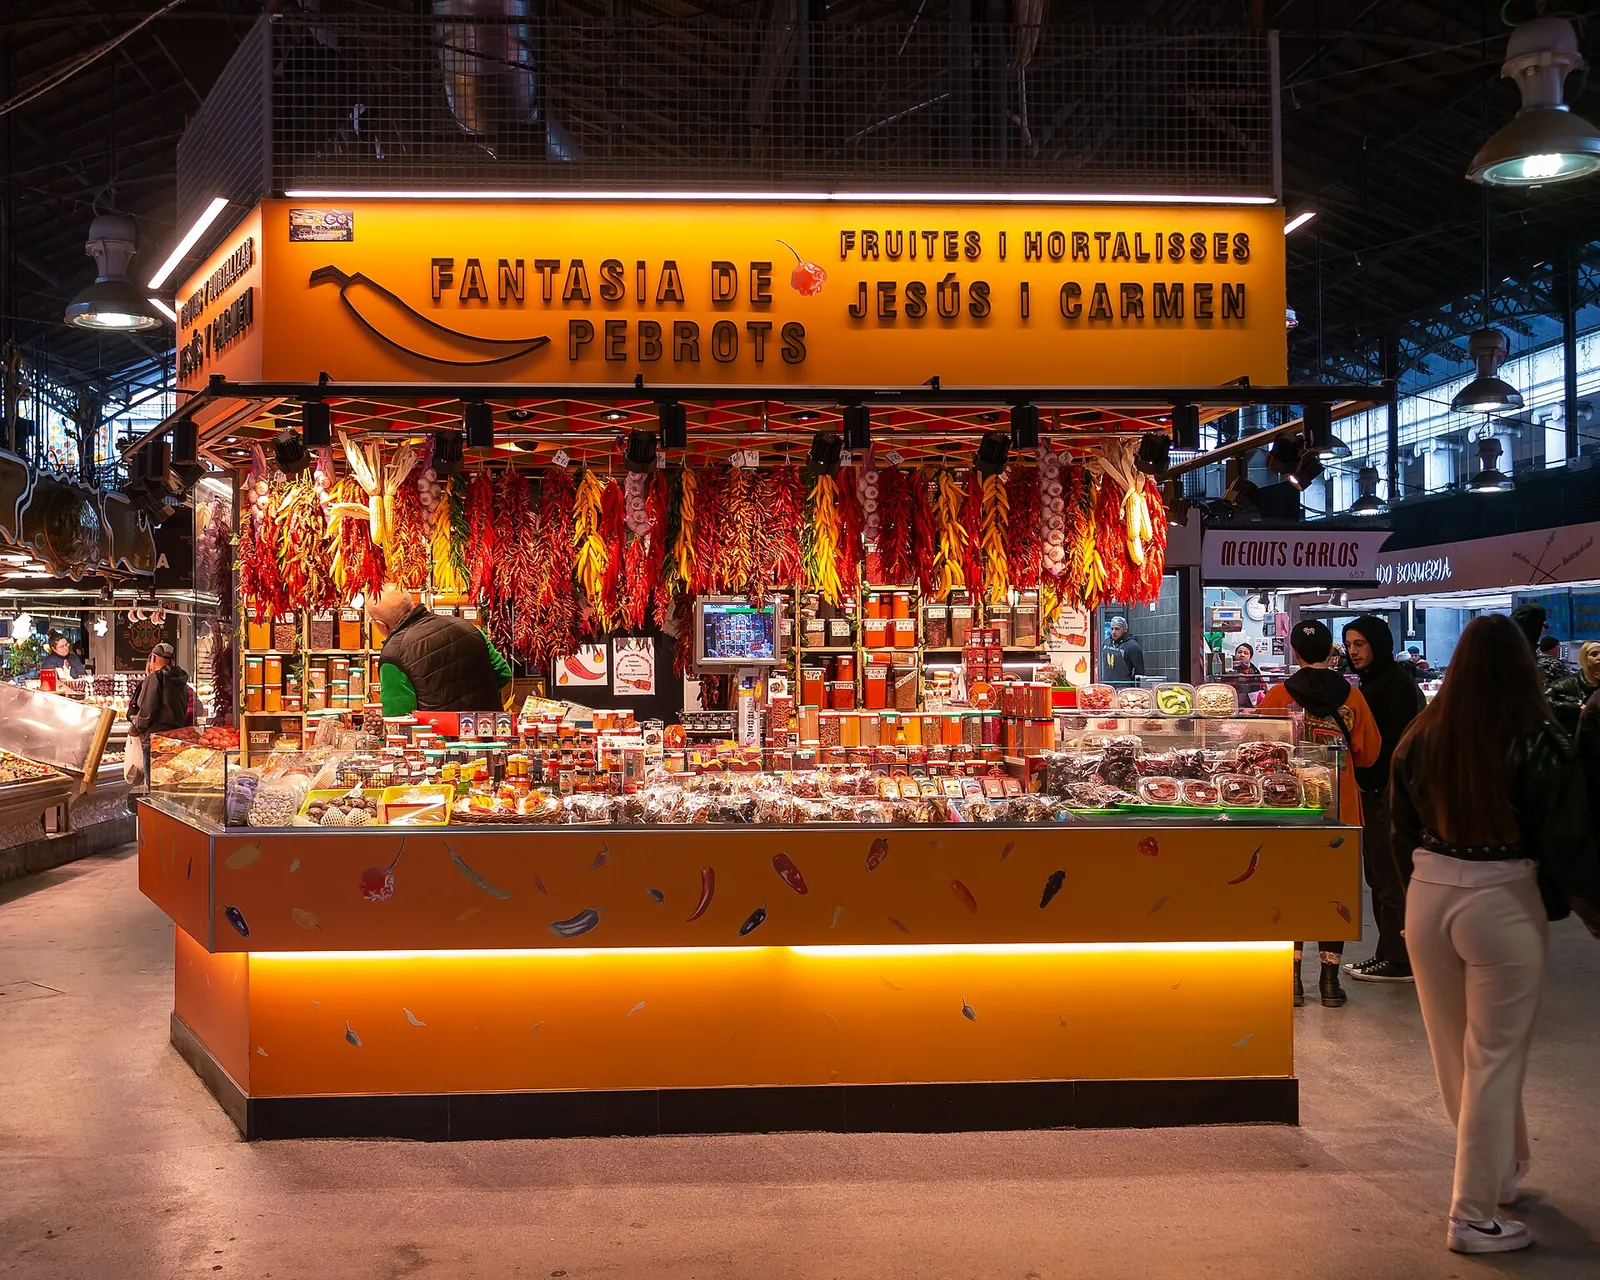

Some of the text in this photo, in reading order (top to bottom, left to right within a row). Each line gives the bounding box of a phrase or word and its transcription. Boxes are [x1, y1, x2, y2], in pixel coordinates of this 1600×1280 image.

[840, 230, 1250, 261] FRUITES I HORTALISSES
[210, 237, 253, 302] HORTALIZAS
[431, 257, 773, 304] FANTASIA DE
[848, 272, 1246, 320] JESÚS I CARMEN
[212, 286, 253, 353] CARMEN
[568, 319, 807, 365] PEBROTS
[1220, 540, 1359, 568] MENUTS CARLOS
[1349, 571, 1365, 579] 657
